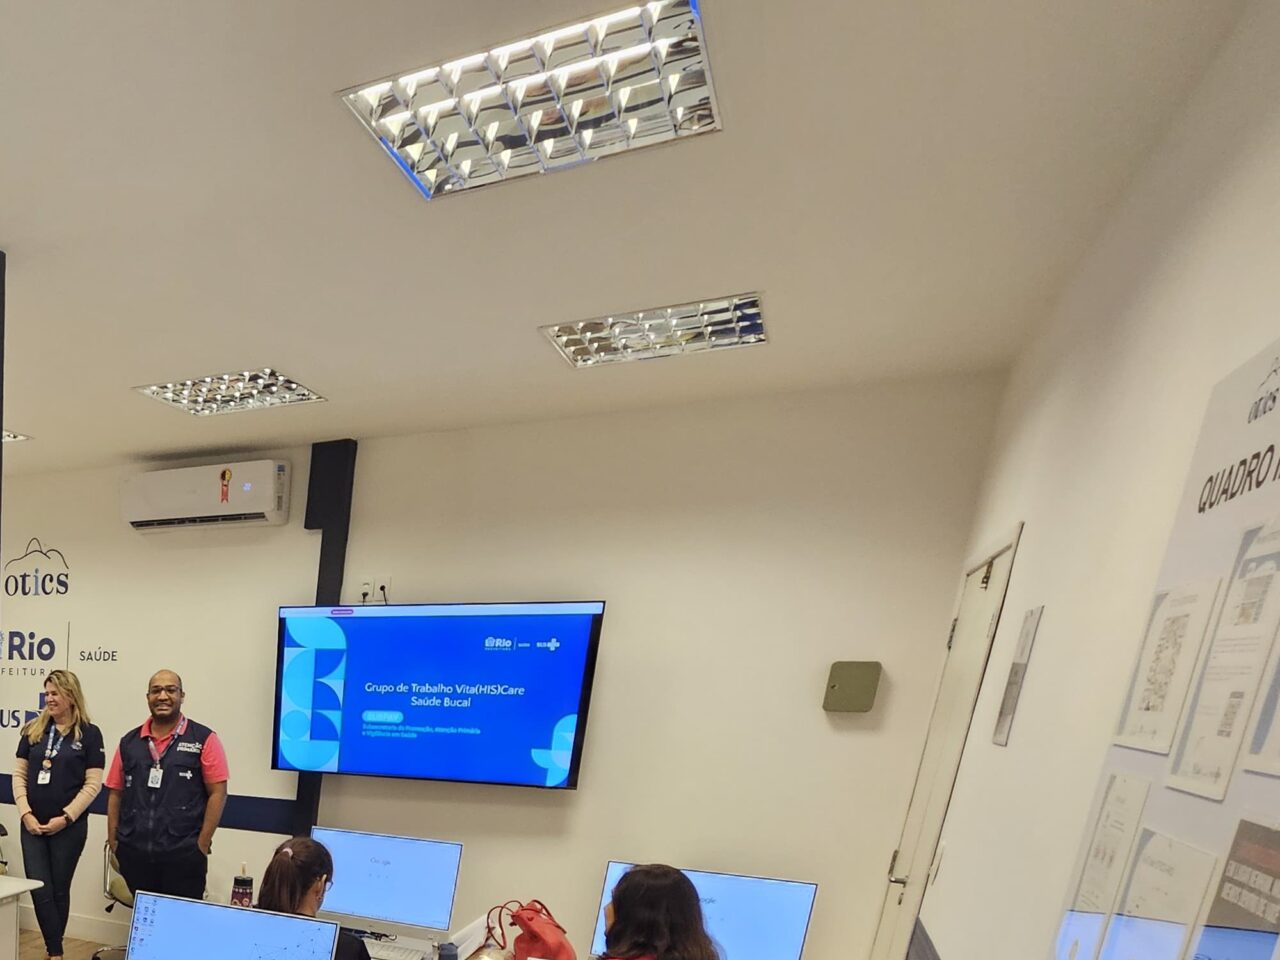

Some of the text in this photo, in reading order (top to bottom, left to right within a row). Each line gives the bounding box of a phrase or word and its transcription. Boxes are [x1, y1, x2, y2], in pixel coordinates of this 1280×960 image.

[1198, 444, 1274, 514] QUADRO
[4, 568, 69, 597] otics
[8, 630, 56, 662] Rio
[495, 638, 512, 647] Rio
[79, 646, 118, 662] SAÚDE
[1, 667, 53, 676] FEITUR
[364, 682, 525, 695] Grupo de Trabalho Vita(HIS)Care
[410, 695, 471, 707] Saúde Bucal
